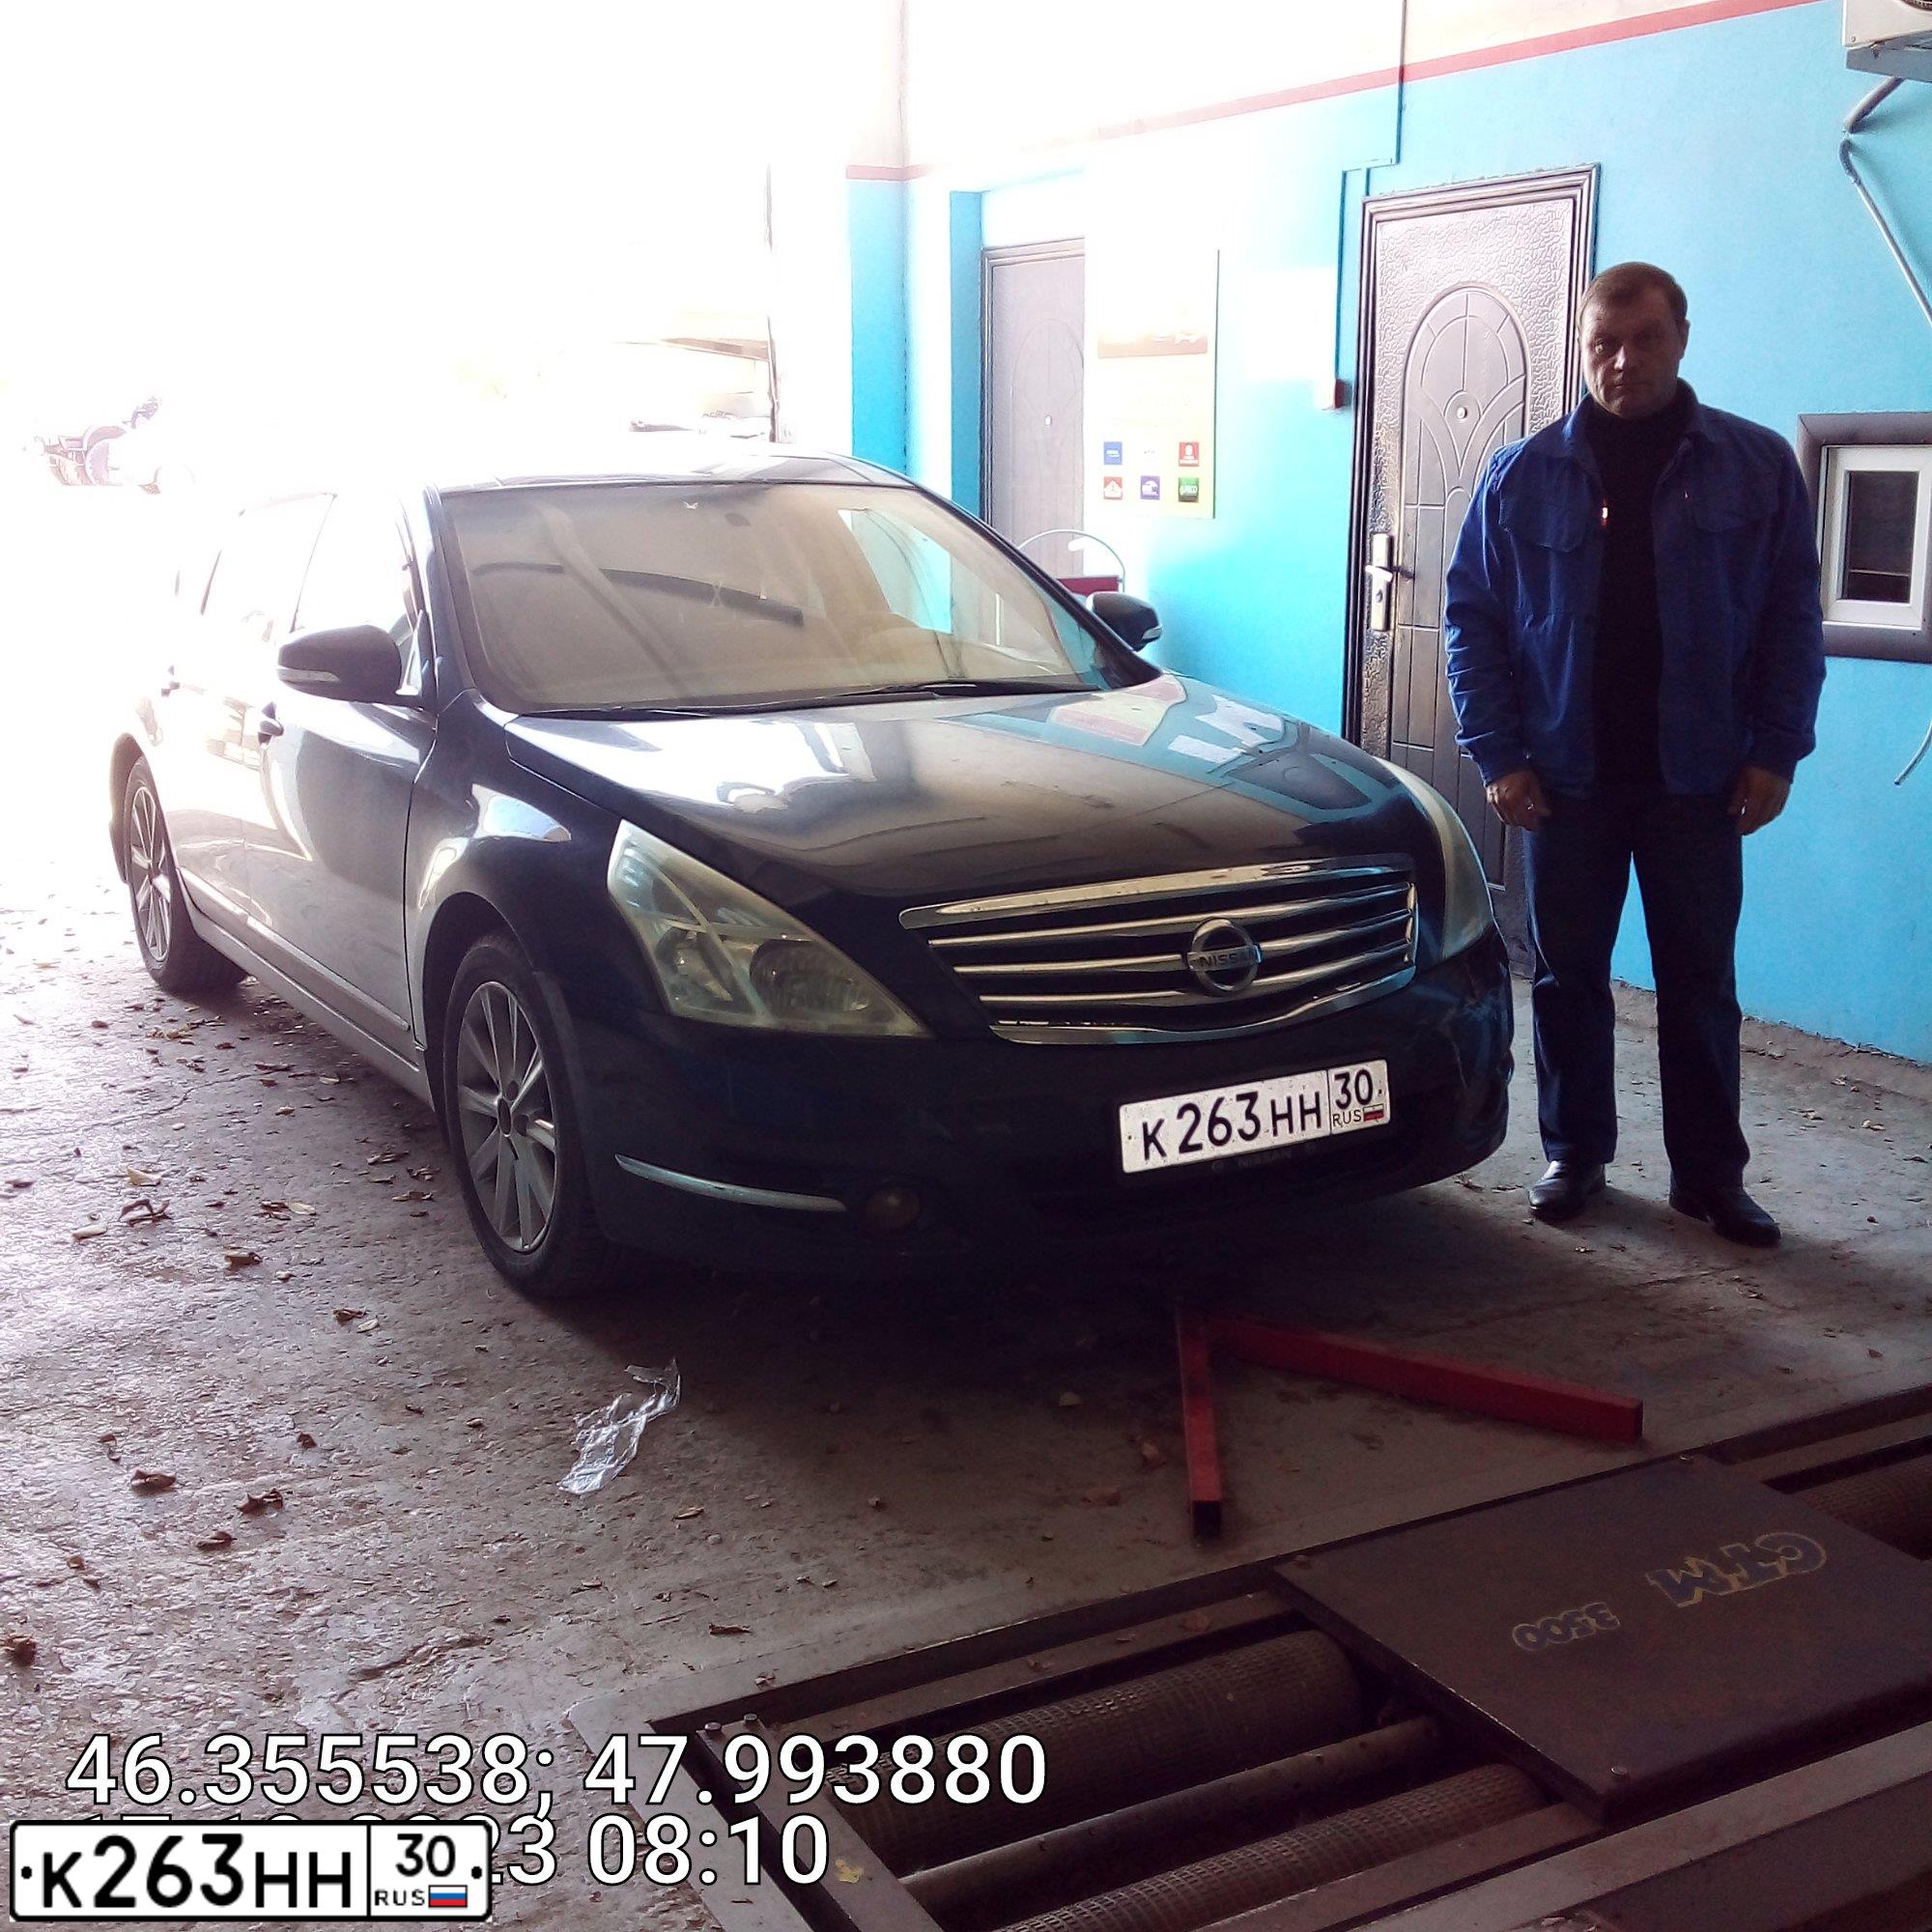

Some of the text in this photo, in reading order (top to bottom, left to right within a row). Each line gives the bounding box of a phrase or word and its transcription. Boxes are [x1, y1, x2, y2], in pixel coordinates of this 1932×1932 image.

[1198, 945, 1258, 968] NISS
[1142, 1068, 1374, 1160] К263НН 30
[1332, 1110, 1362, 1128] RUS
[1512, 1602, 1621, 1651] 3500
